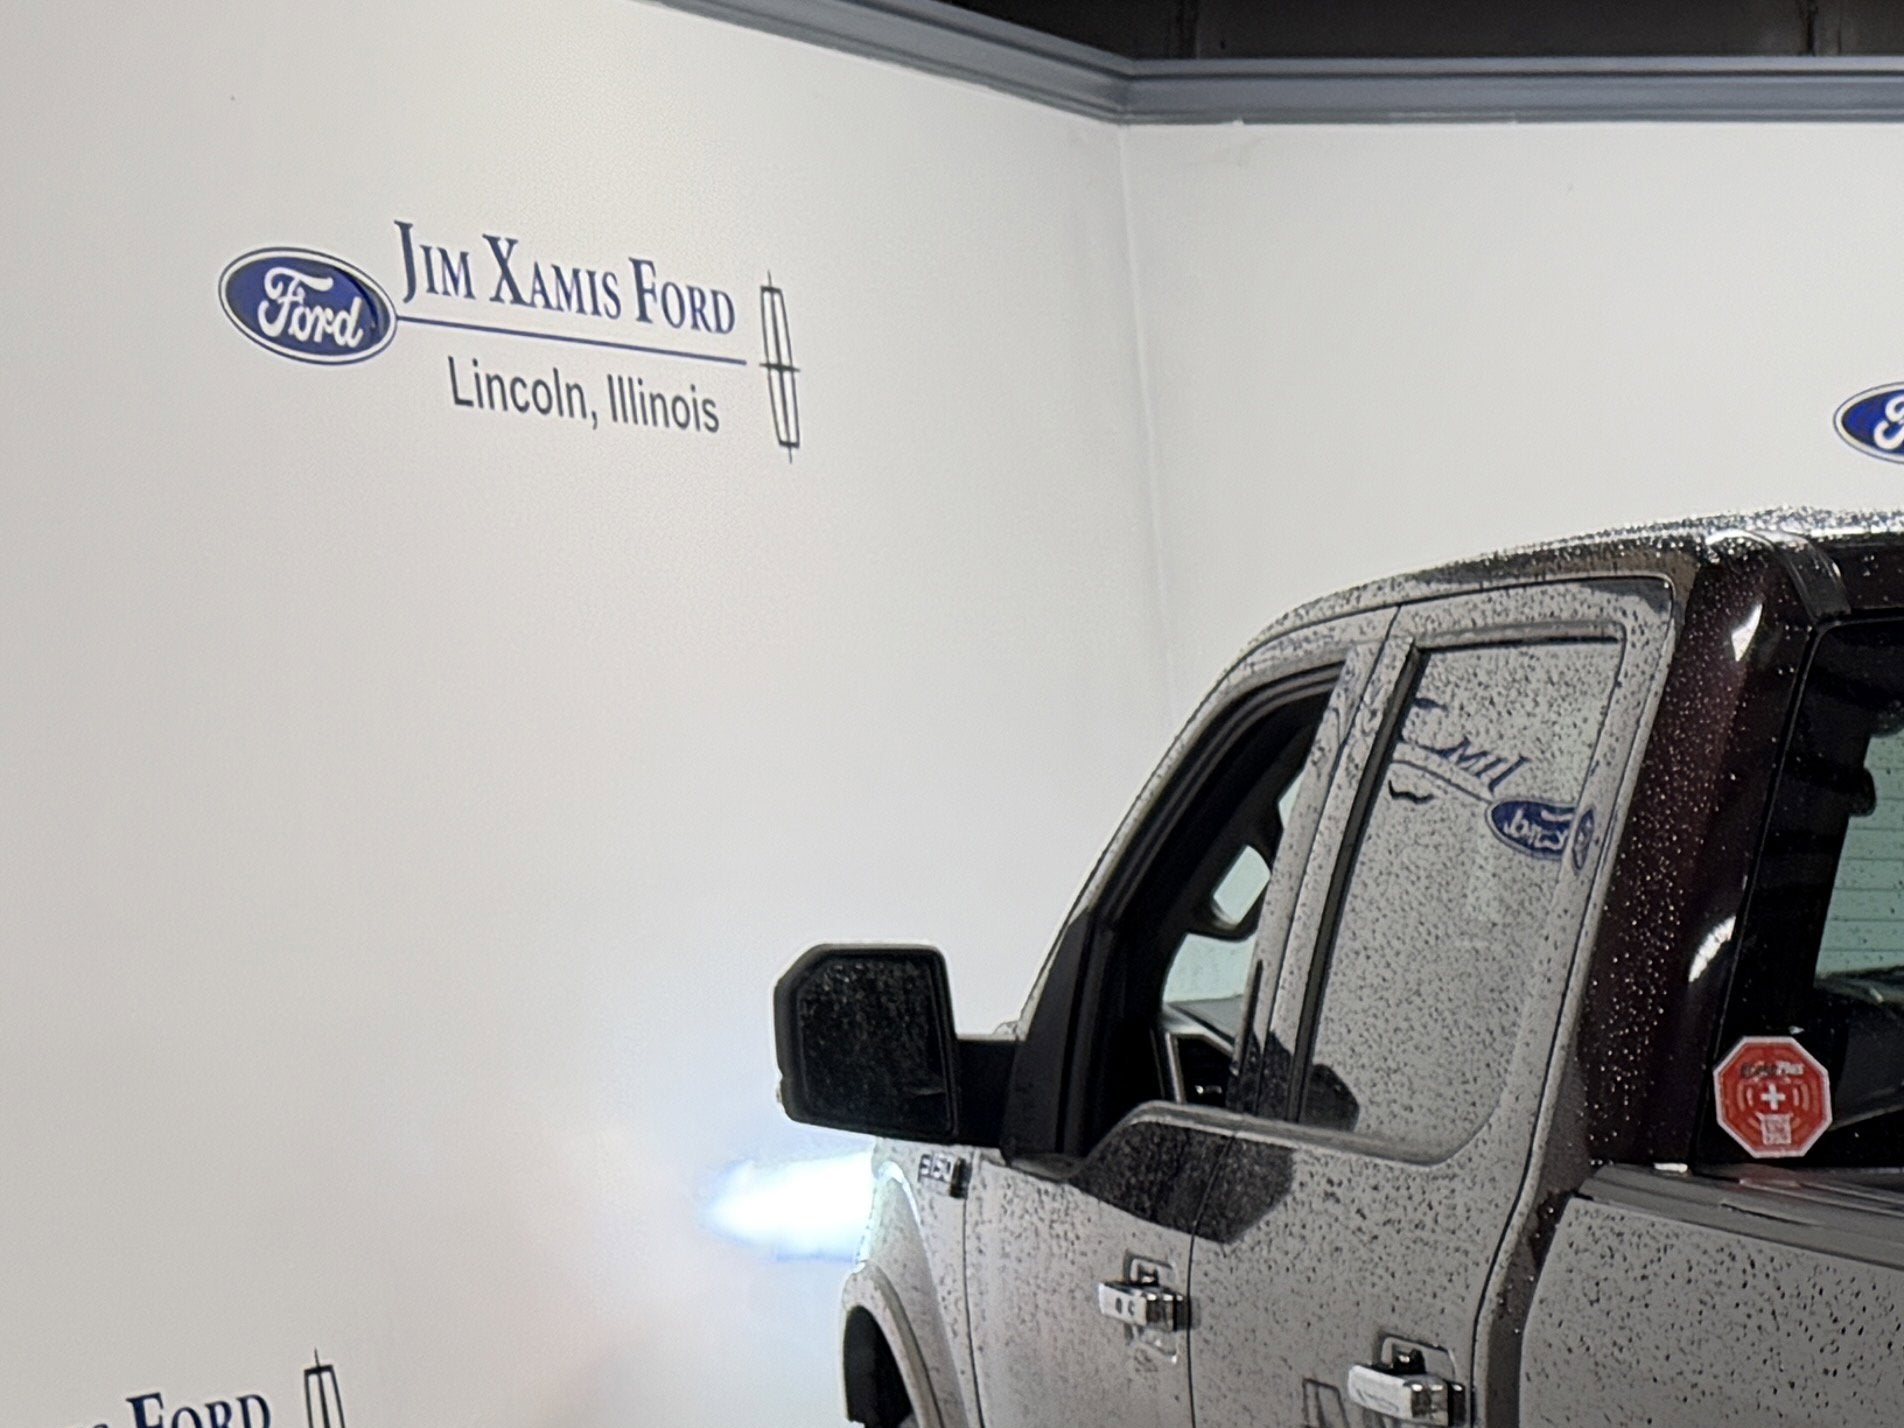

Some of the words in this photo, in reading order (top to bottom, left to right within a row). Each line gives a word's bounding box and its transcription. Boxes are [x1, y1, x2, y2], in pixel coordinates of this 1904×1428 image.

[257, 265, 364, 348] Ford
[447, 355, 599, 429] Lincoln,
[608, 374, 721, 434] Illinois
